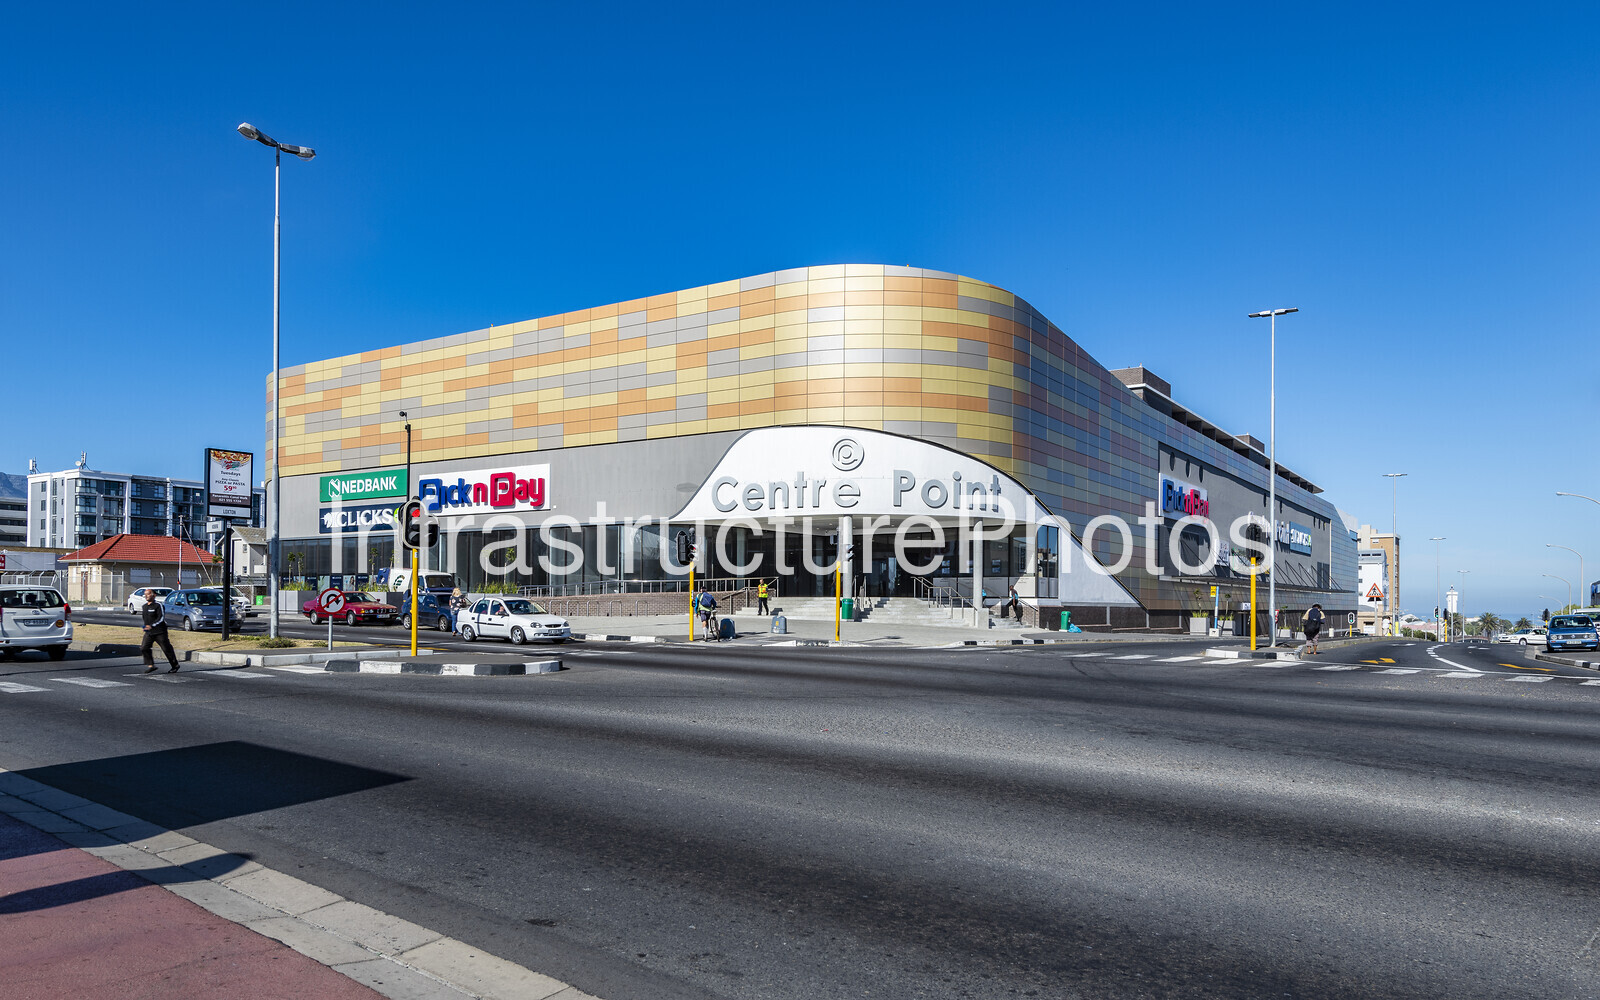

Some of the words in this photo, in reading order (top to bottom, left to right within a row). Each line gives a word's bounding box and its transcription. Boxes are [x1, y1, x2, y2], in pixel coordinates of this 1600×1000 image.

[341, 476, 397, 494] NEDBANK
[418, 478, 472, 513] Pick
[473, 482, 488, 505] n
[490, 472, 545, 510] Pay
[711, 471, 861, 513] Centre
[893, 469, 1002, 513] Point
[339, 507, 394, 527] CLICKS
